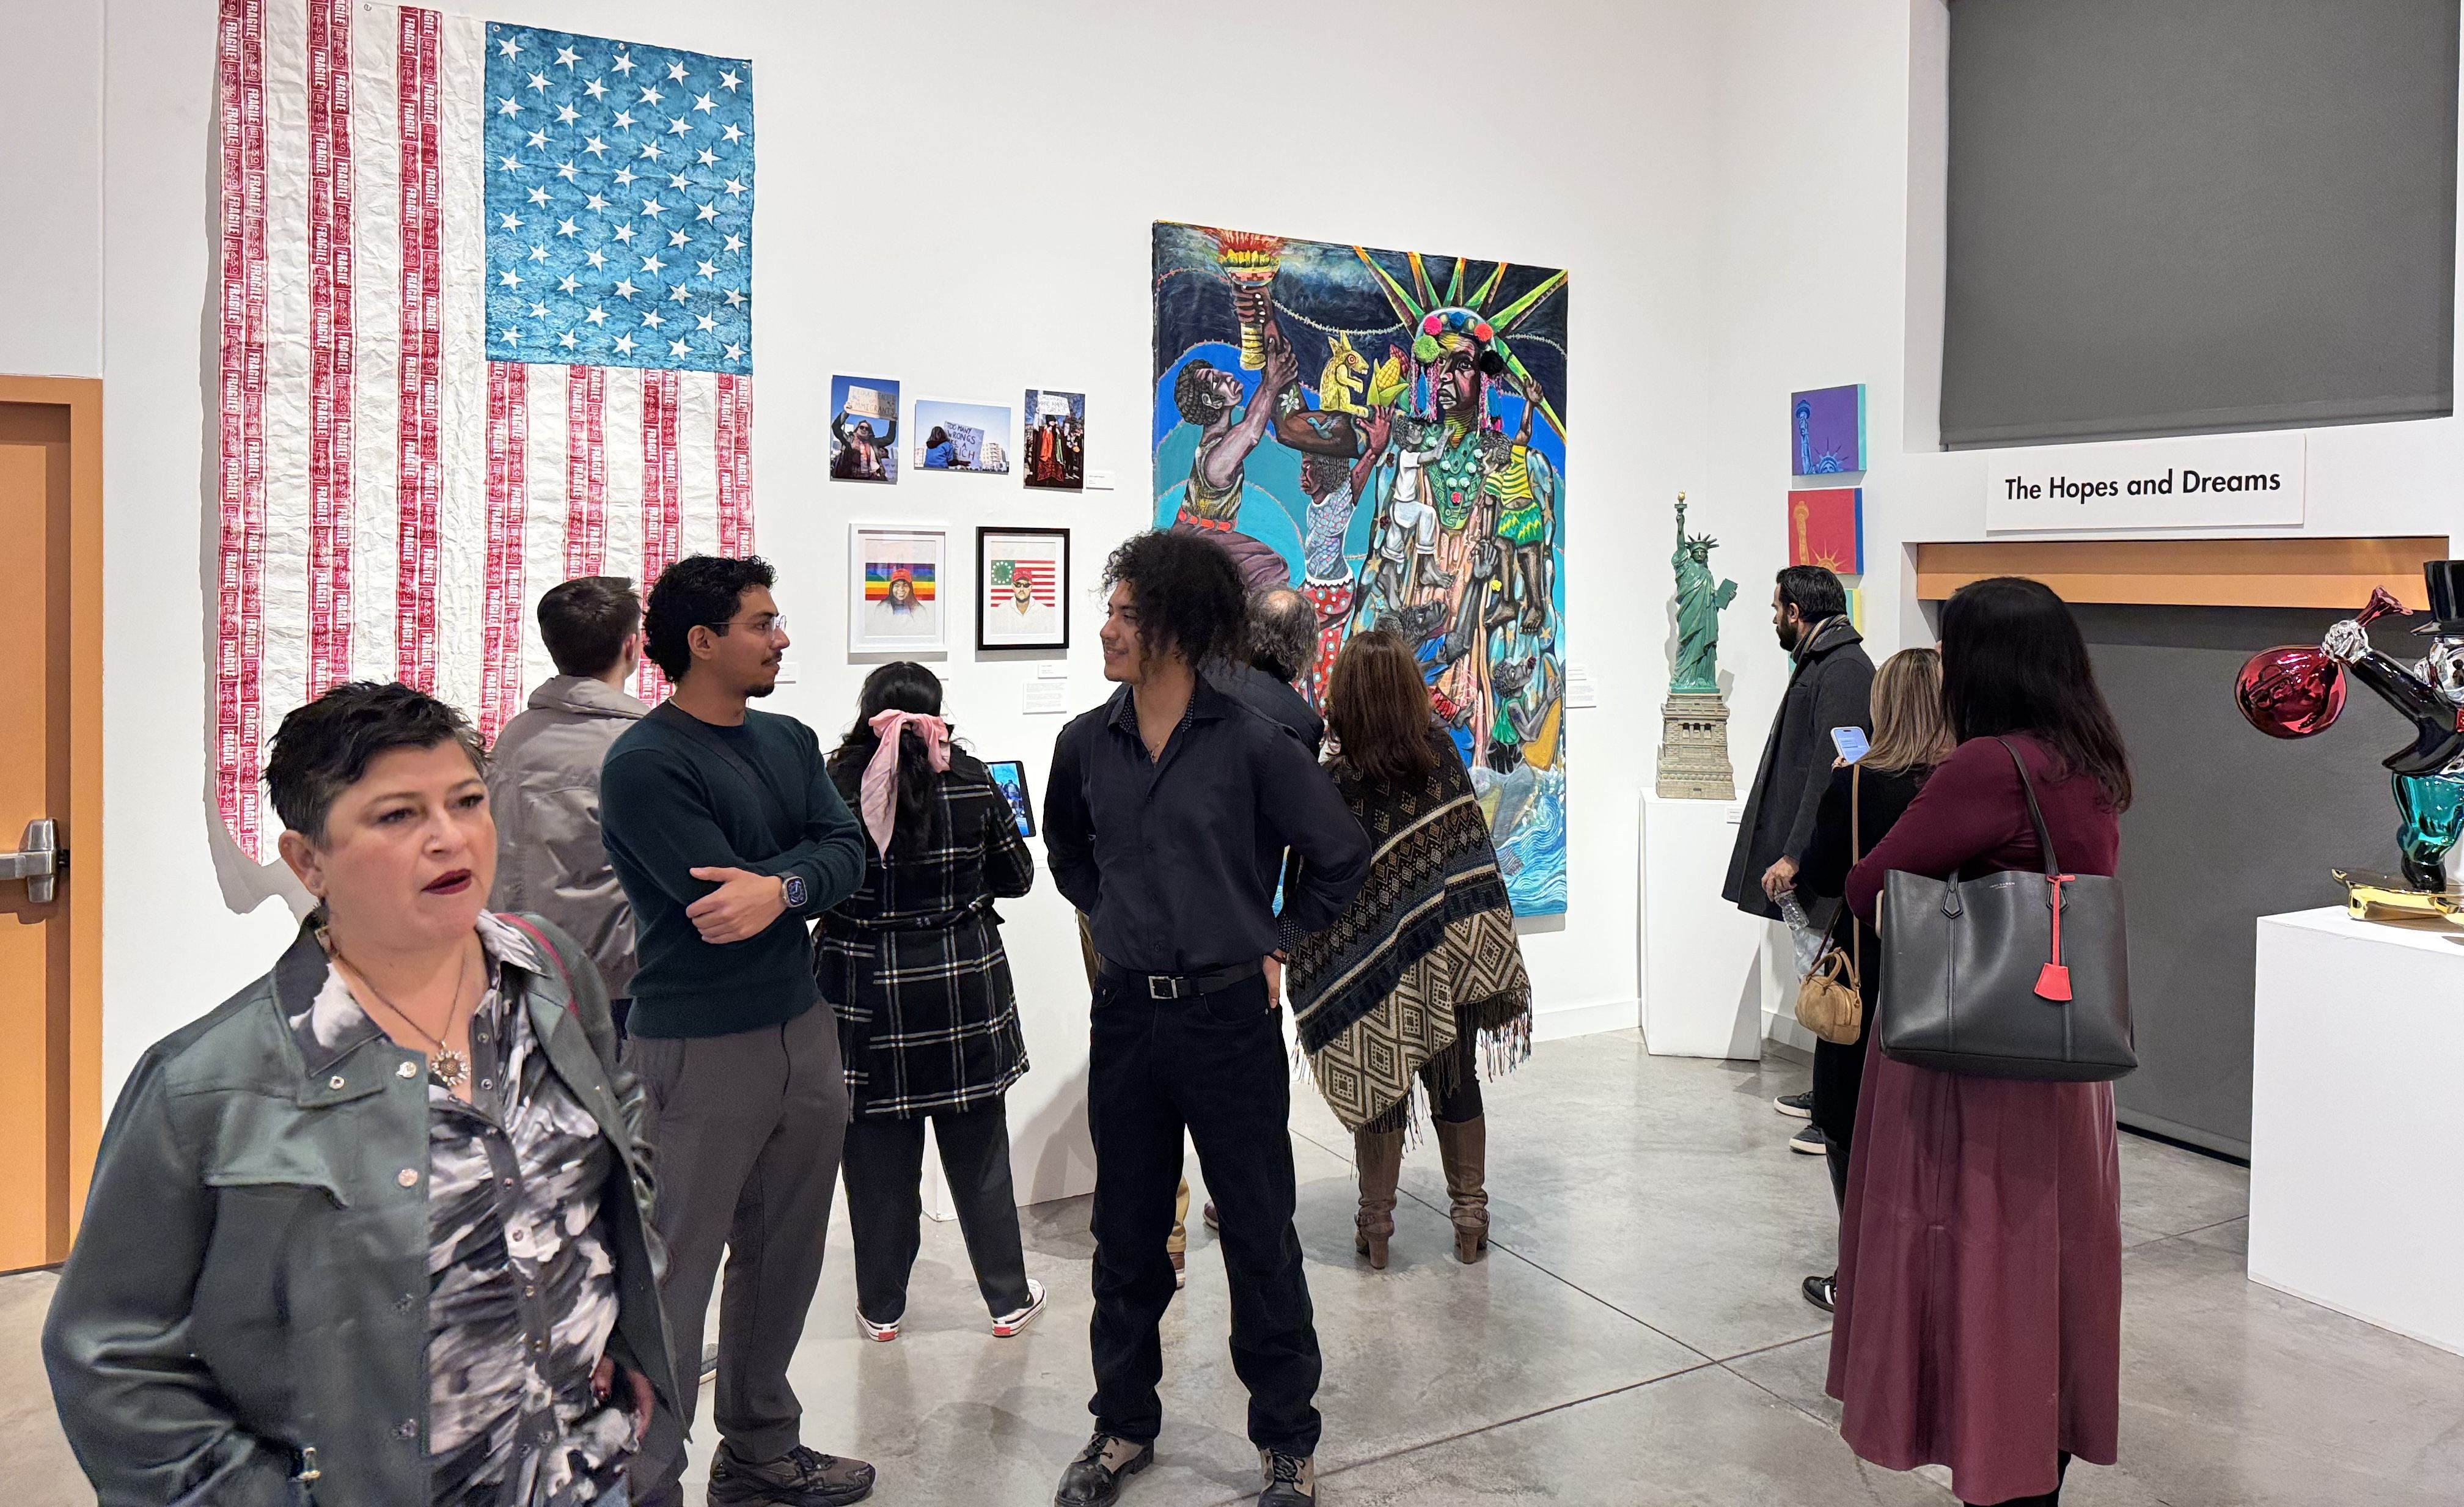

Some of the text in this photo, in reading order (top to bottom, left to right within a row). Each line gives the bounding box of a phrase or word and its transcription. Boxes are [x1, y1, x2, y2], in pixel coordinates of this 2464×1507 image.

[246, 1, 258, 38] FRAGILE
[335, 0, 346, 24] AGILE
[424, 11, 436, 37] AGILE
[226, 21, 238, 59] FRAGILE
[405, 16, 417, 54] FRAGILE
[314, 51, 326, 87] FRAGILE
[246, 87, 258, 124] FRAGILE
[335, 75, 347, 111] FRAGILE
[424, 82, 436, 122] FRAGILE
[227, 108, 239, 146] FRAGILE
[404, 103, 416, 141] FRAGILE
[316, 138, 328, 175] FRAGILE
[337, 162, 348, 199] FRAGILE
[425, 169, 438, 206] FRAGILE
[229, 194, 241, 235] FRAGILE
[405, 186, 417, 224] FRAGILE
[316, 226, 328, 262] FRAGILE
[251, 263, 263, 302] FRAGILE
[337, 249, 348, 286] FRAGILE
[229, 282, 241, 320] FRAGILE
[406, 270, 419, 309] FRAGILE
[317, 311, 329, 348] FRAGILE
[425, 296, 438, 332] FRAGILE
[248, 351, 260, 389] FRAGILE
[337, 334, 348, 372] FRAGILE
[226, 372, 239, 412] FRAGILE
[405, 356, 416, 393] FRAGILE
[590, 367, 602, 402] FRAGILE
[425, 380, 436, 416] FRAGILE
[572, 380, 584, 419] FRAGILE
[721, 394, 732, 428] FRAGILE
[316, 399, 328, 438] FRAGILE
[512, 403, 523, 441] FRAGILE
[947, 422, 972, 434] TOO MANY
[337, 422, 348, 461] FRAGILE
[493, 422, 504, 461] FRAGILE
[647, 428, 658, 462] FRAGILE
[947, 430, 975, 445] WRONGS
[953, 446, 975, 460] EICH
[248, 441, 260, 478] FRAGILE
[404, 441, 416, 478] FRAGILE
[591, 447, 603, 482] FRAGILE
[664, 450, 676, 486] FRAGILE
[737, 453, 747, 486] FRAGILE
[226, 463, 238, 500] FRAGILE
[424, 463, 436, 501] FRAGILE
[573, 462, 585, 498] FRAGILE
[722, 472, 732, 504] FRAGILE
[2005, 468, 2281, 504] The Hopes and Dreams
[317, 486, 328, 522] FRAGILE
[337, 507, 348, 546] FRAGILE
[491, 505, 502, 543] FRAGILE
[648, 507, 659, 541] FRAGILE
[248, 531, 258, 570] FRAGILE
[403, 525, 415, 563] FRAGILE
[589, 526, 600, 560] FRAGILE
[665, 528, 676, 561] FRAGILE
[739, 530, 750, 557] FRAGIL
[226, 552, 238, 591] FRAGILE
[423, 548, 435, 585] FRAGILE
[315, 572, 327, 610] FRAGILE
[508, 568, 520, 604] FRAGILE
[246, 618, 258, 655] FRAGILE
[402, 612, 413, 648] FRAGILE
[224, 640, 236, 679] FRAGILE
[421, 632, 433, 669] FRAGILE
[244, 707, 256, 744] FRAGILE
[222, 728, 235, 766] FRAGILE
[244, 794, 255, 832] FRAGILE
